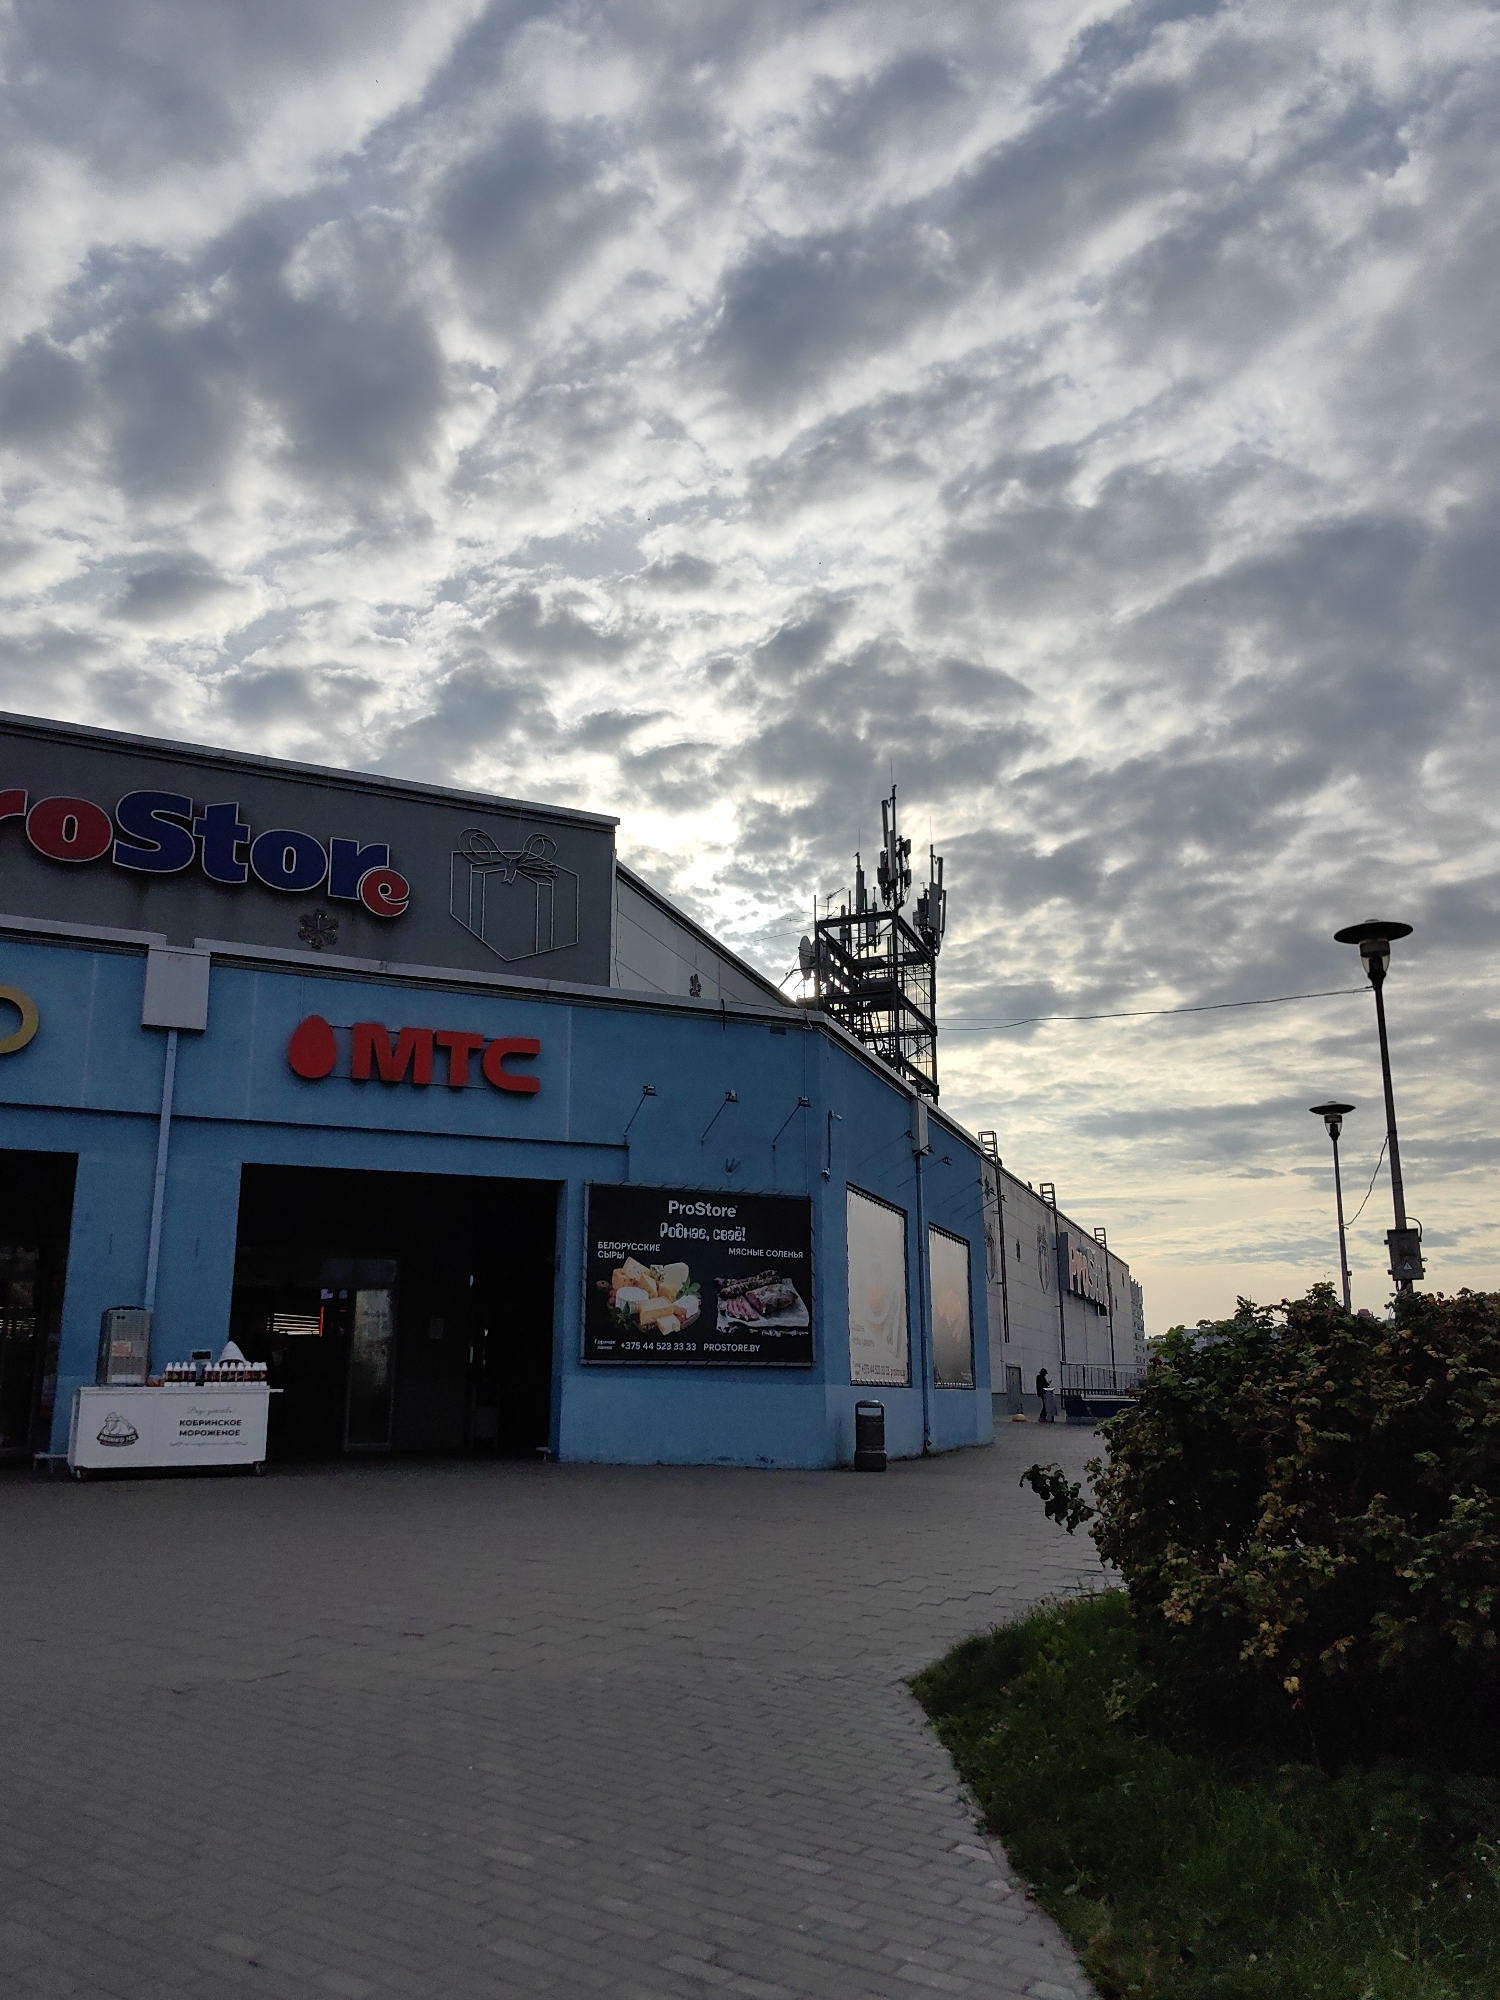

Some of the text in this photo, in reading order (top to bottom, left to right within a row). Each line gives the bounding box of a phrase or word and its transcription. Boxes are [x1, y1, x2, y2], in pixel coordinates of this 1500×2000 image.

[352, 1023, 540, 1094] МТС
[669, 1199, 737, 1217] ProStore
[660, 1222, 746, 1242] Роднае, сваё!
[597, 1241, 661, 1251] БЕЛОРУССКИЕ
[597, 1250, 625, 1259] СЫРЫ
[728, 1247, 804, 1259] МЯСНЫЕ СОЛЕНЬЯ
[620, 1341, 641, 1351] +375
[642, 1342, 654, 1351] 44
[656, 1342, 672, 1351] 523
[673, 1342, 684, 1351] 33
[685, 1342, 697, 1351] 33
[703, 1342, 761, 1352] PROSTORE.BY
[179, 1419, 242, 1427] КОБРИНСКОЕ
[179, 1429, 240, 1437] МОРОЖЕНОЕ
